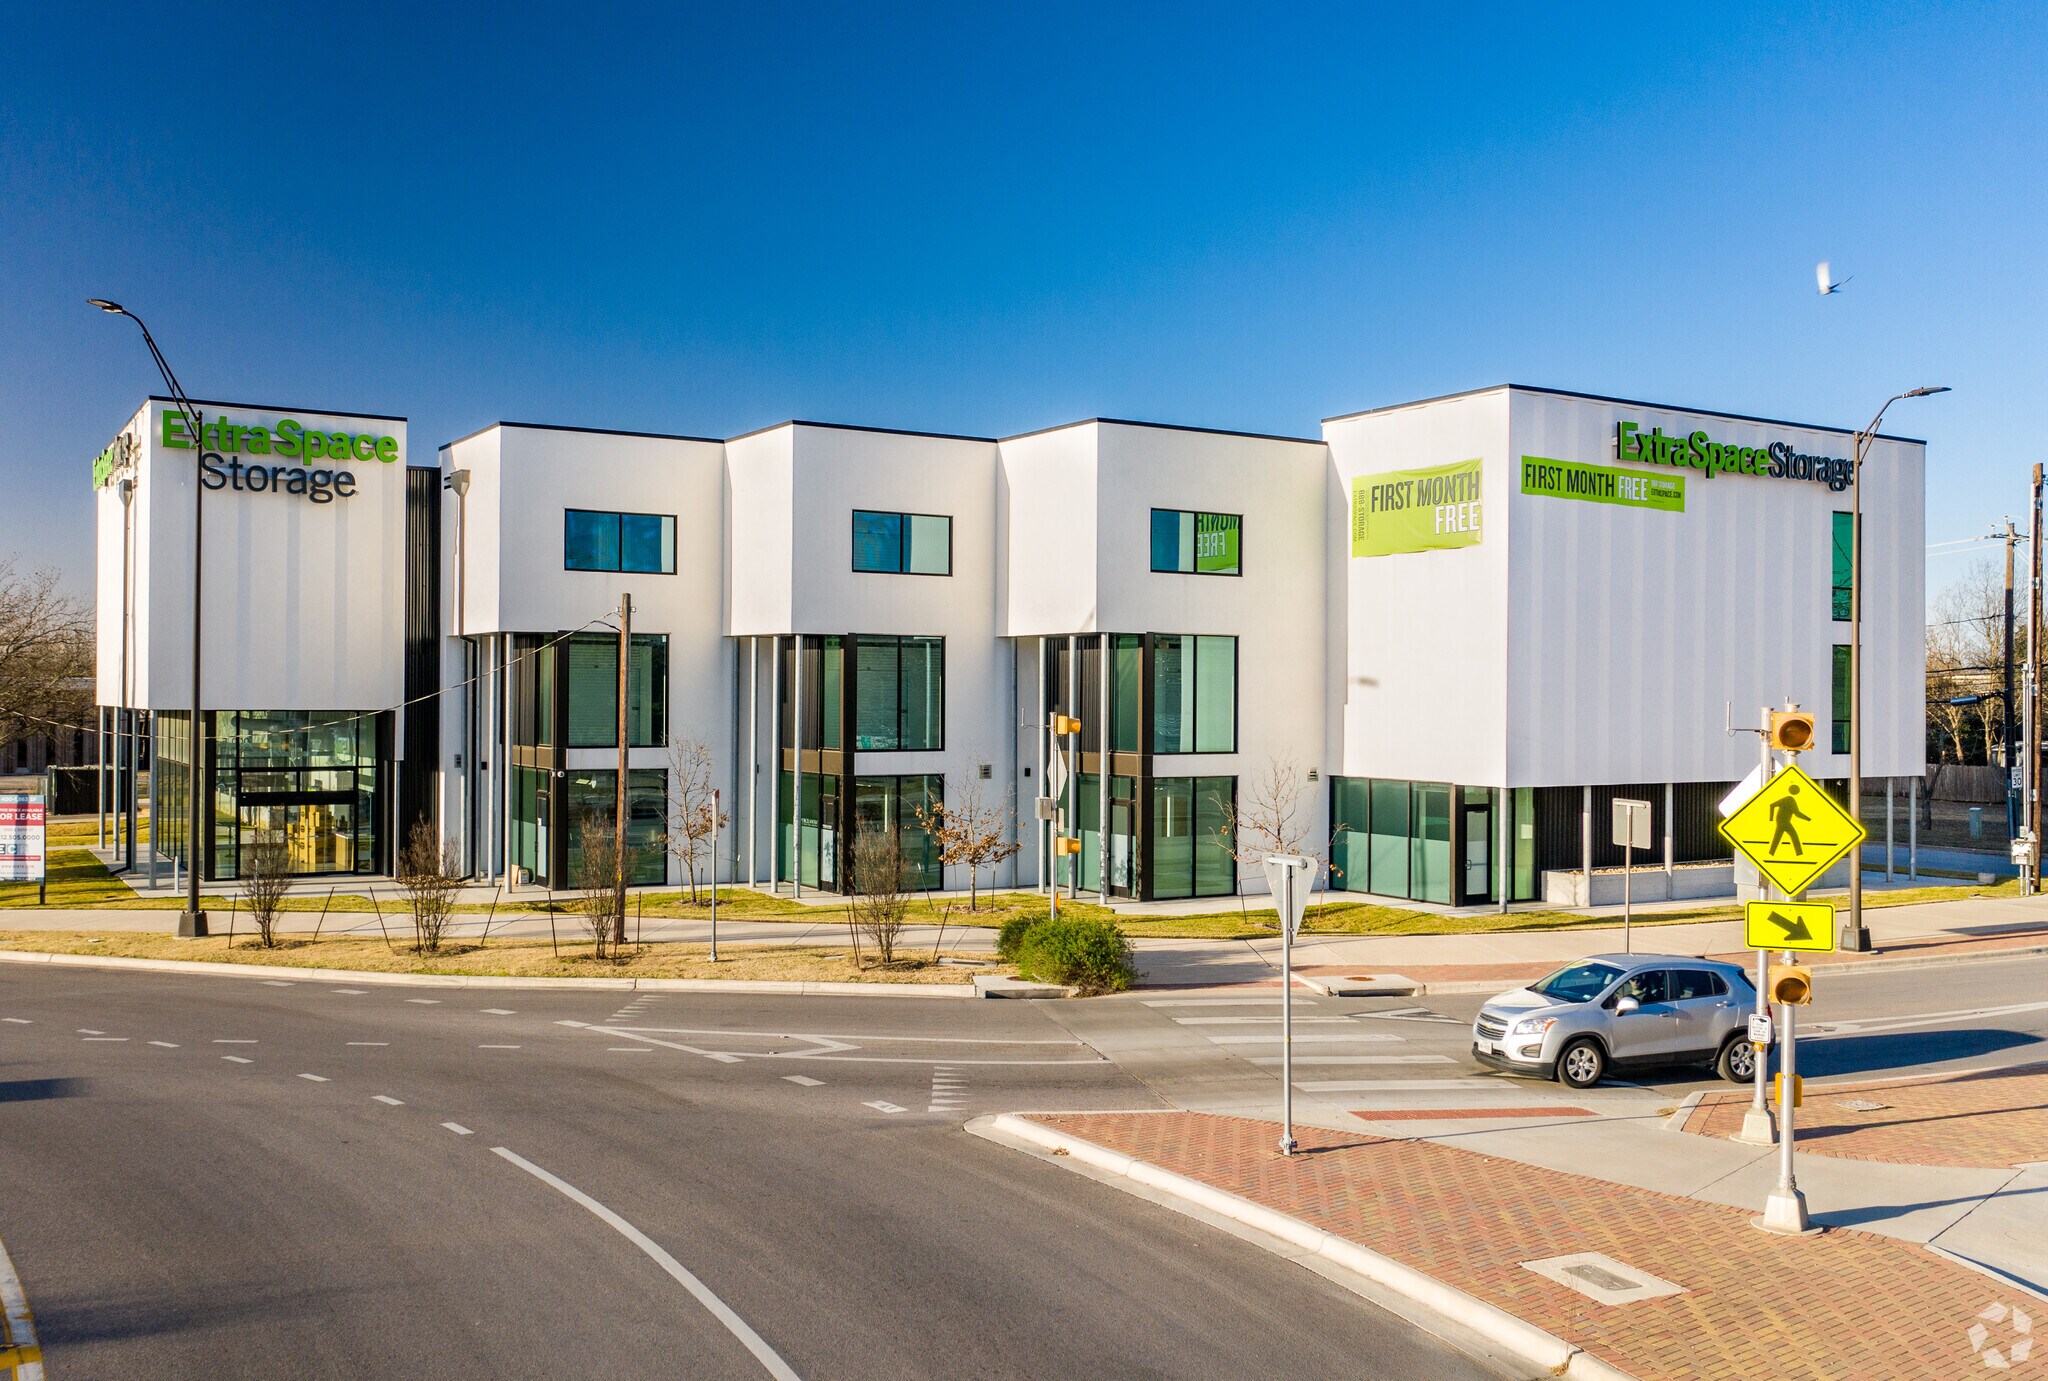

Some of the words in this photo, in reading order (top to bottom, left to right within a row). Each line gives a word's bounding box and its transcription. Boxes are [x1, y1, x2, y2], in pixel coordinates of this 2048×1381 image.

[162, 409, 399, 466] ExtraSpace
[1371, 480, 1414, 512] FIRST
[1416, 470, 1480, 507] MONTH
[1525, 463, 1563, 491] FIRST
[1566, 469, 1615, 497] MONTH
[1618, 475, 1648, 501] FREE
[1435, 501, 1480, 535] FREE
[2013, 777, 2021, 786] 30
